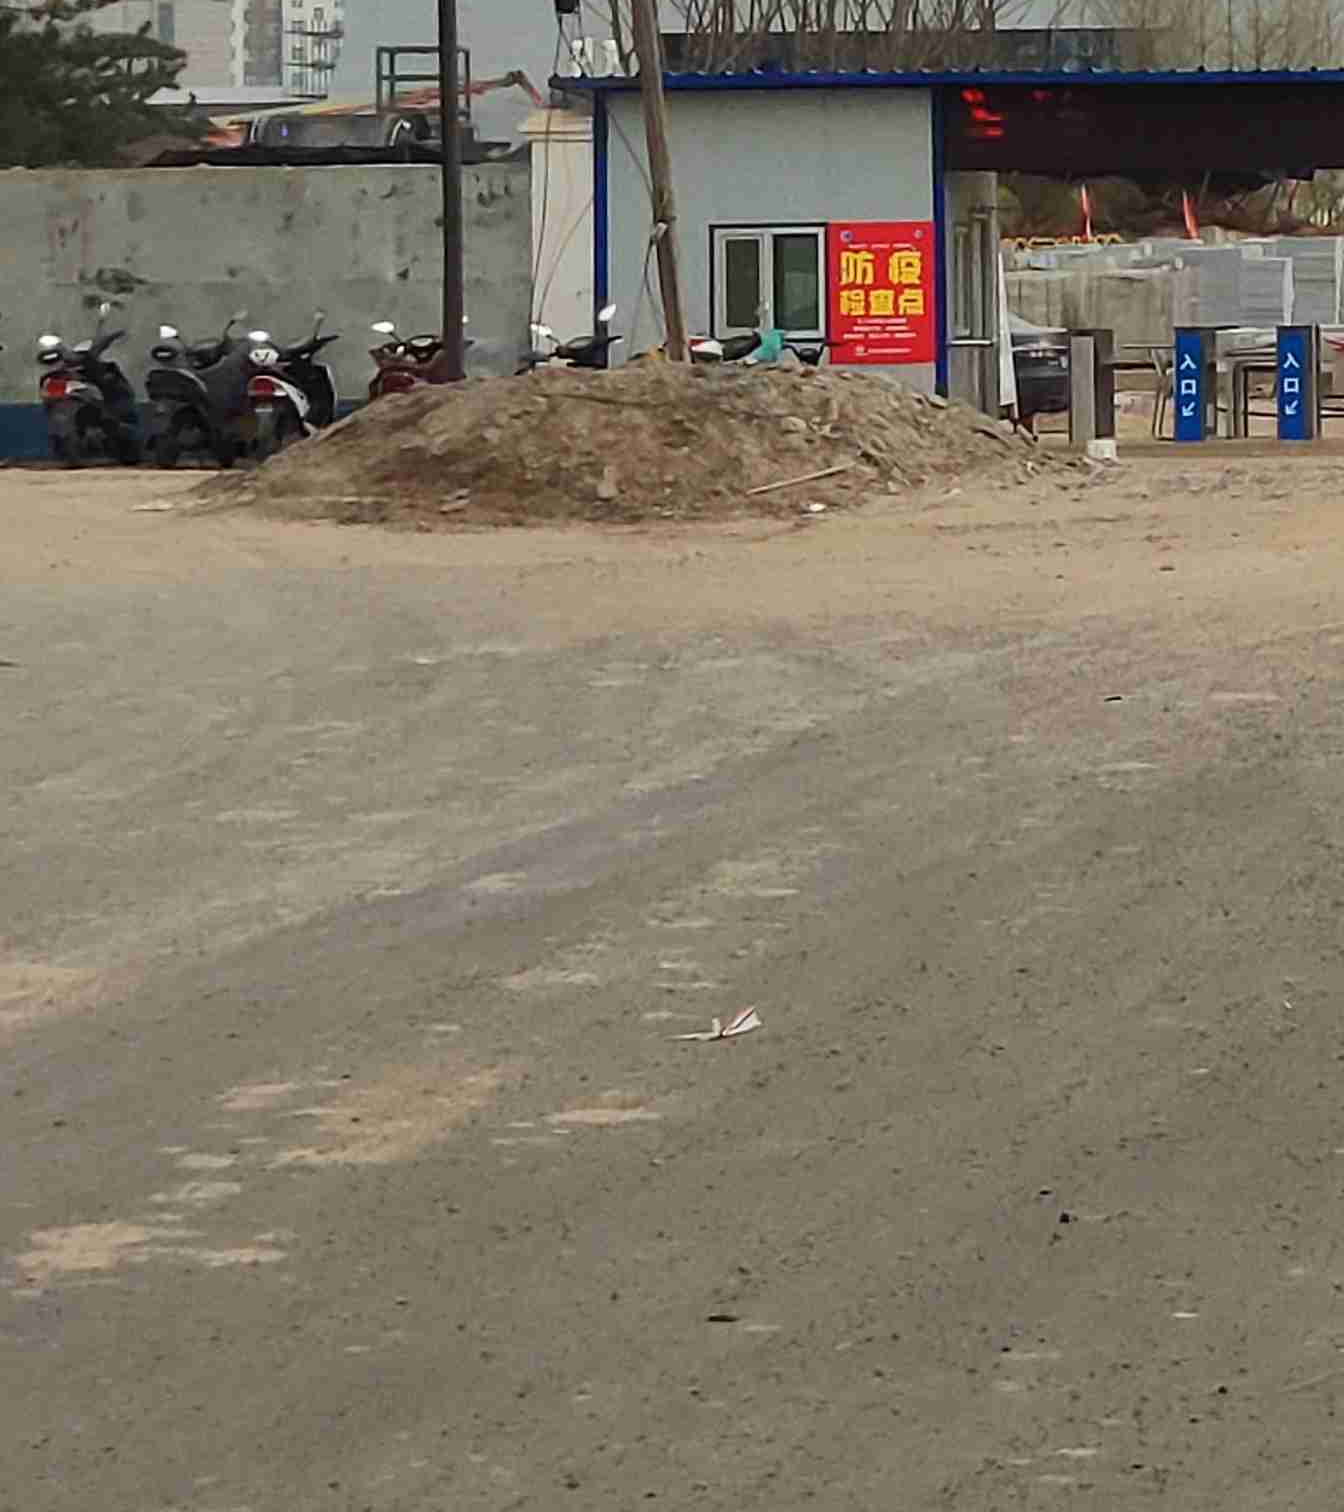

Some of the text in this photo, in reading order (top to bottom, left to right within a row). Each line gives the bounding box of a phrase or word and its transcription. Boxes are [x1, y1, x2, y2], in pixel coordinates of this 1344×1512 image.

[839, 250, 922, 286] 防疫
[1179, 353, 1197, 396] 入口
[1283, 352, 1300, 394] 入口
